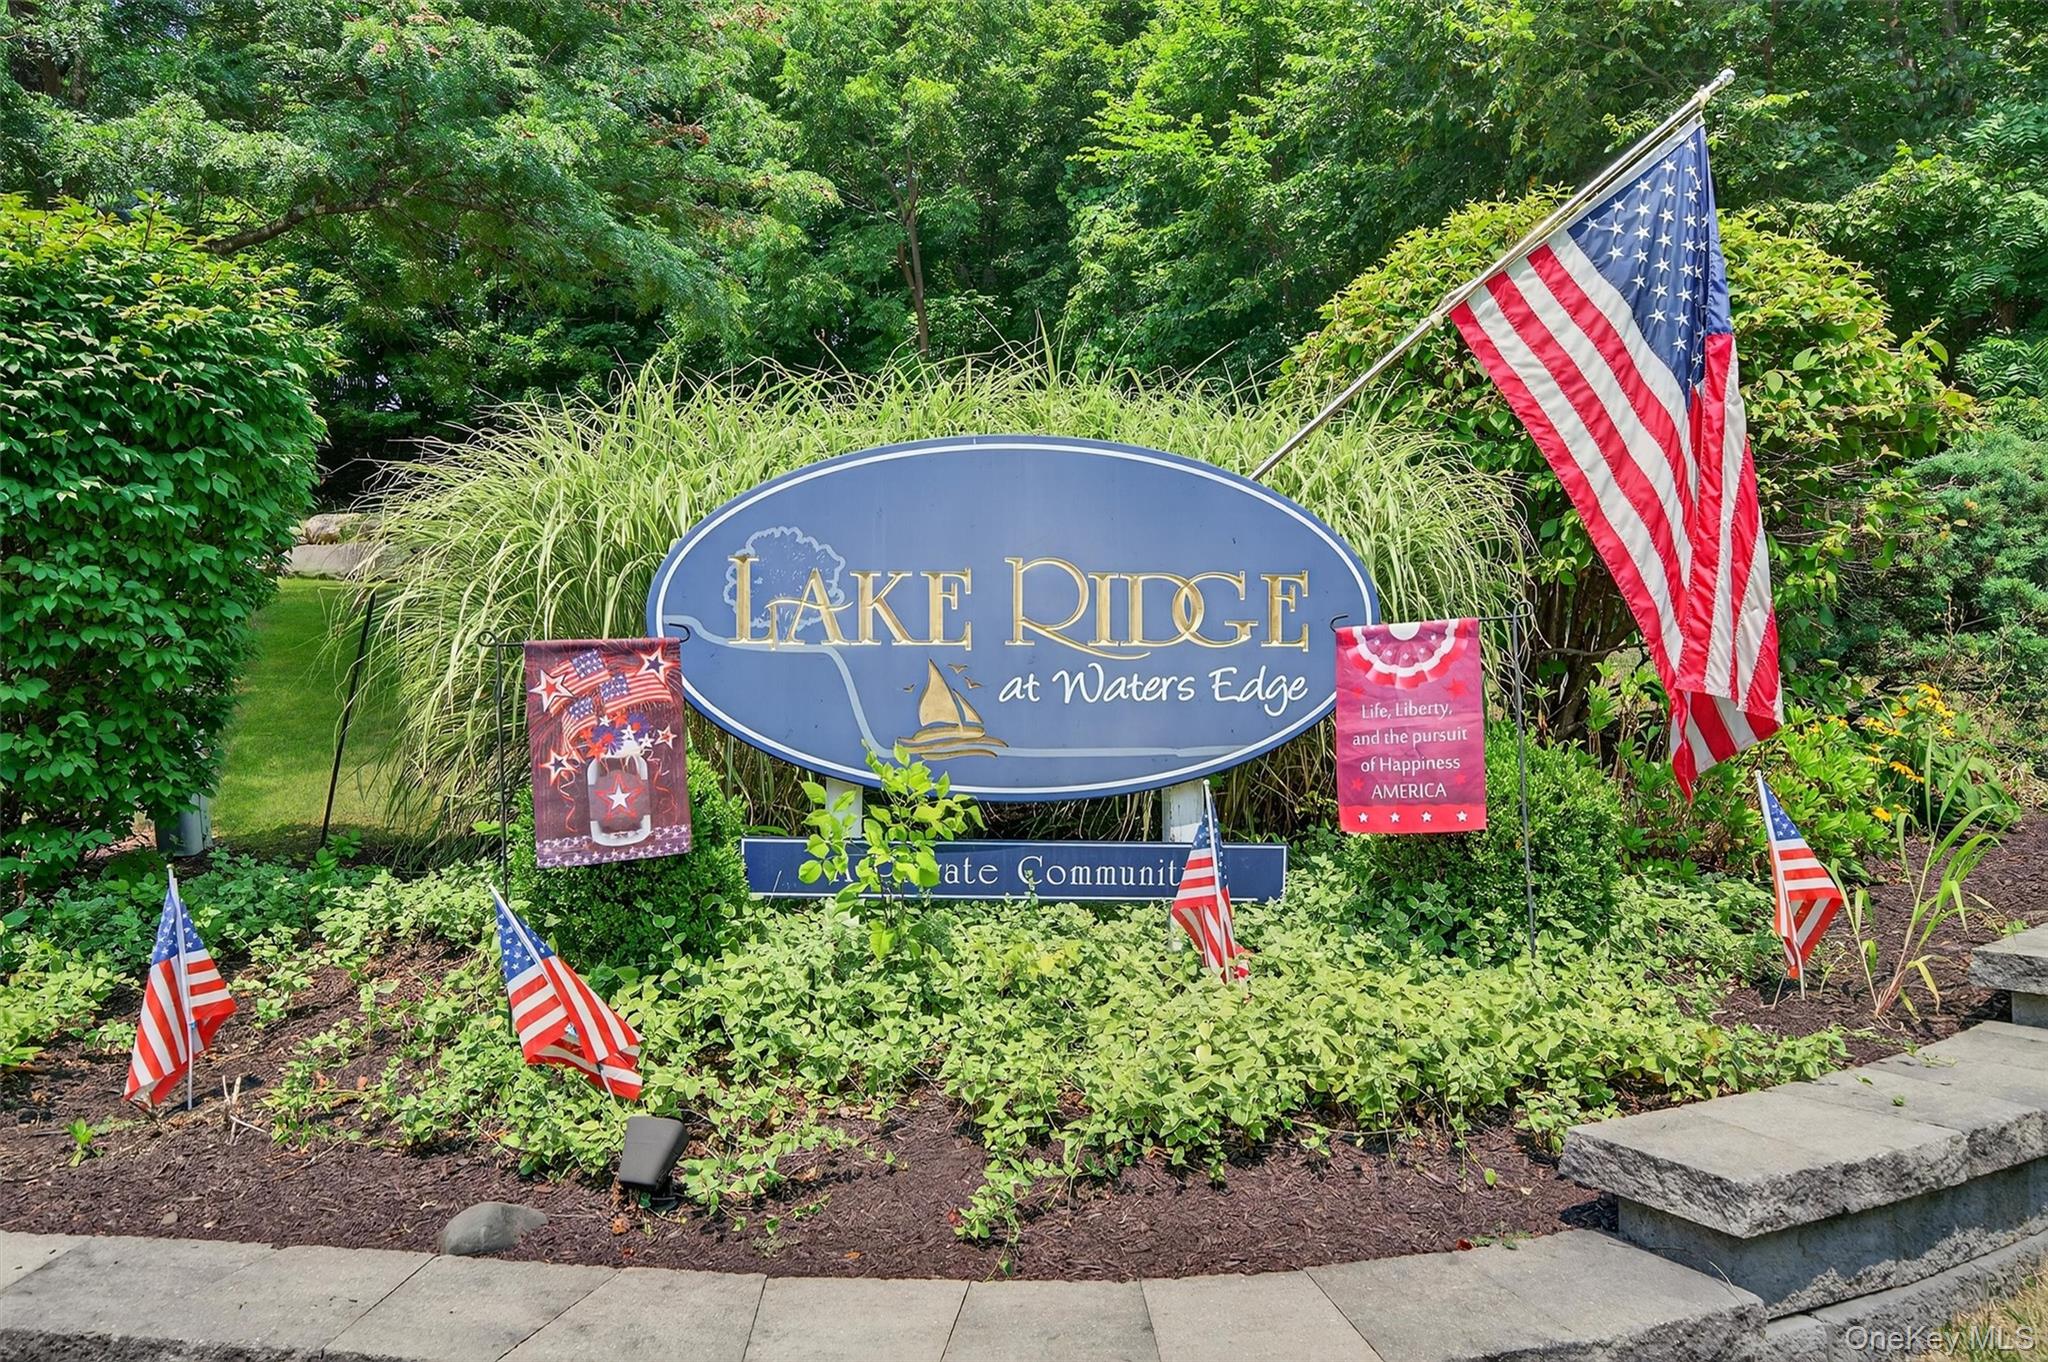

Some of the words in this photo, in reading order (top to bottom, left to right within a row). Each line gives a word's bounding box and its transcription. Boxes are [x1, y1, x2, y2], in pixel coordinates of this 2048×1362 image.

[727, 553, 973, 651] LAKE
[1003, 557, 1310, 661] RIDGE
[998, 672, 1040, 704] at
[1051, 662, 1196, 704] Waters
[1208, 665, 1309, 718] Edge
[1361, 703, 1392, 720] Life,
[1395, 702, 1453, 721] Liberty,
[1352, 730, 1380, 746] and
[1384, 729, 1409, 745] the
[1412, 727, 1468, 748] pursuit
[1360, 757, 1376, 772] of
[1379, 757, 1461, 776] Happiness
[1371, 782, 1448, 799] AMERICA
[1017, 855, 1187, 886] Communit
